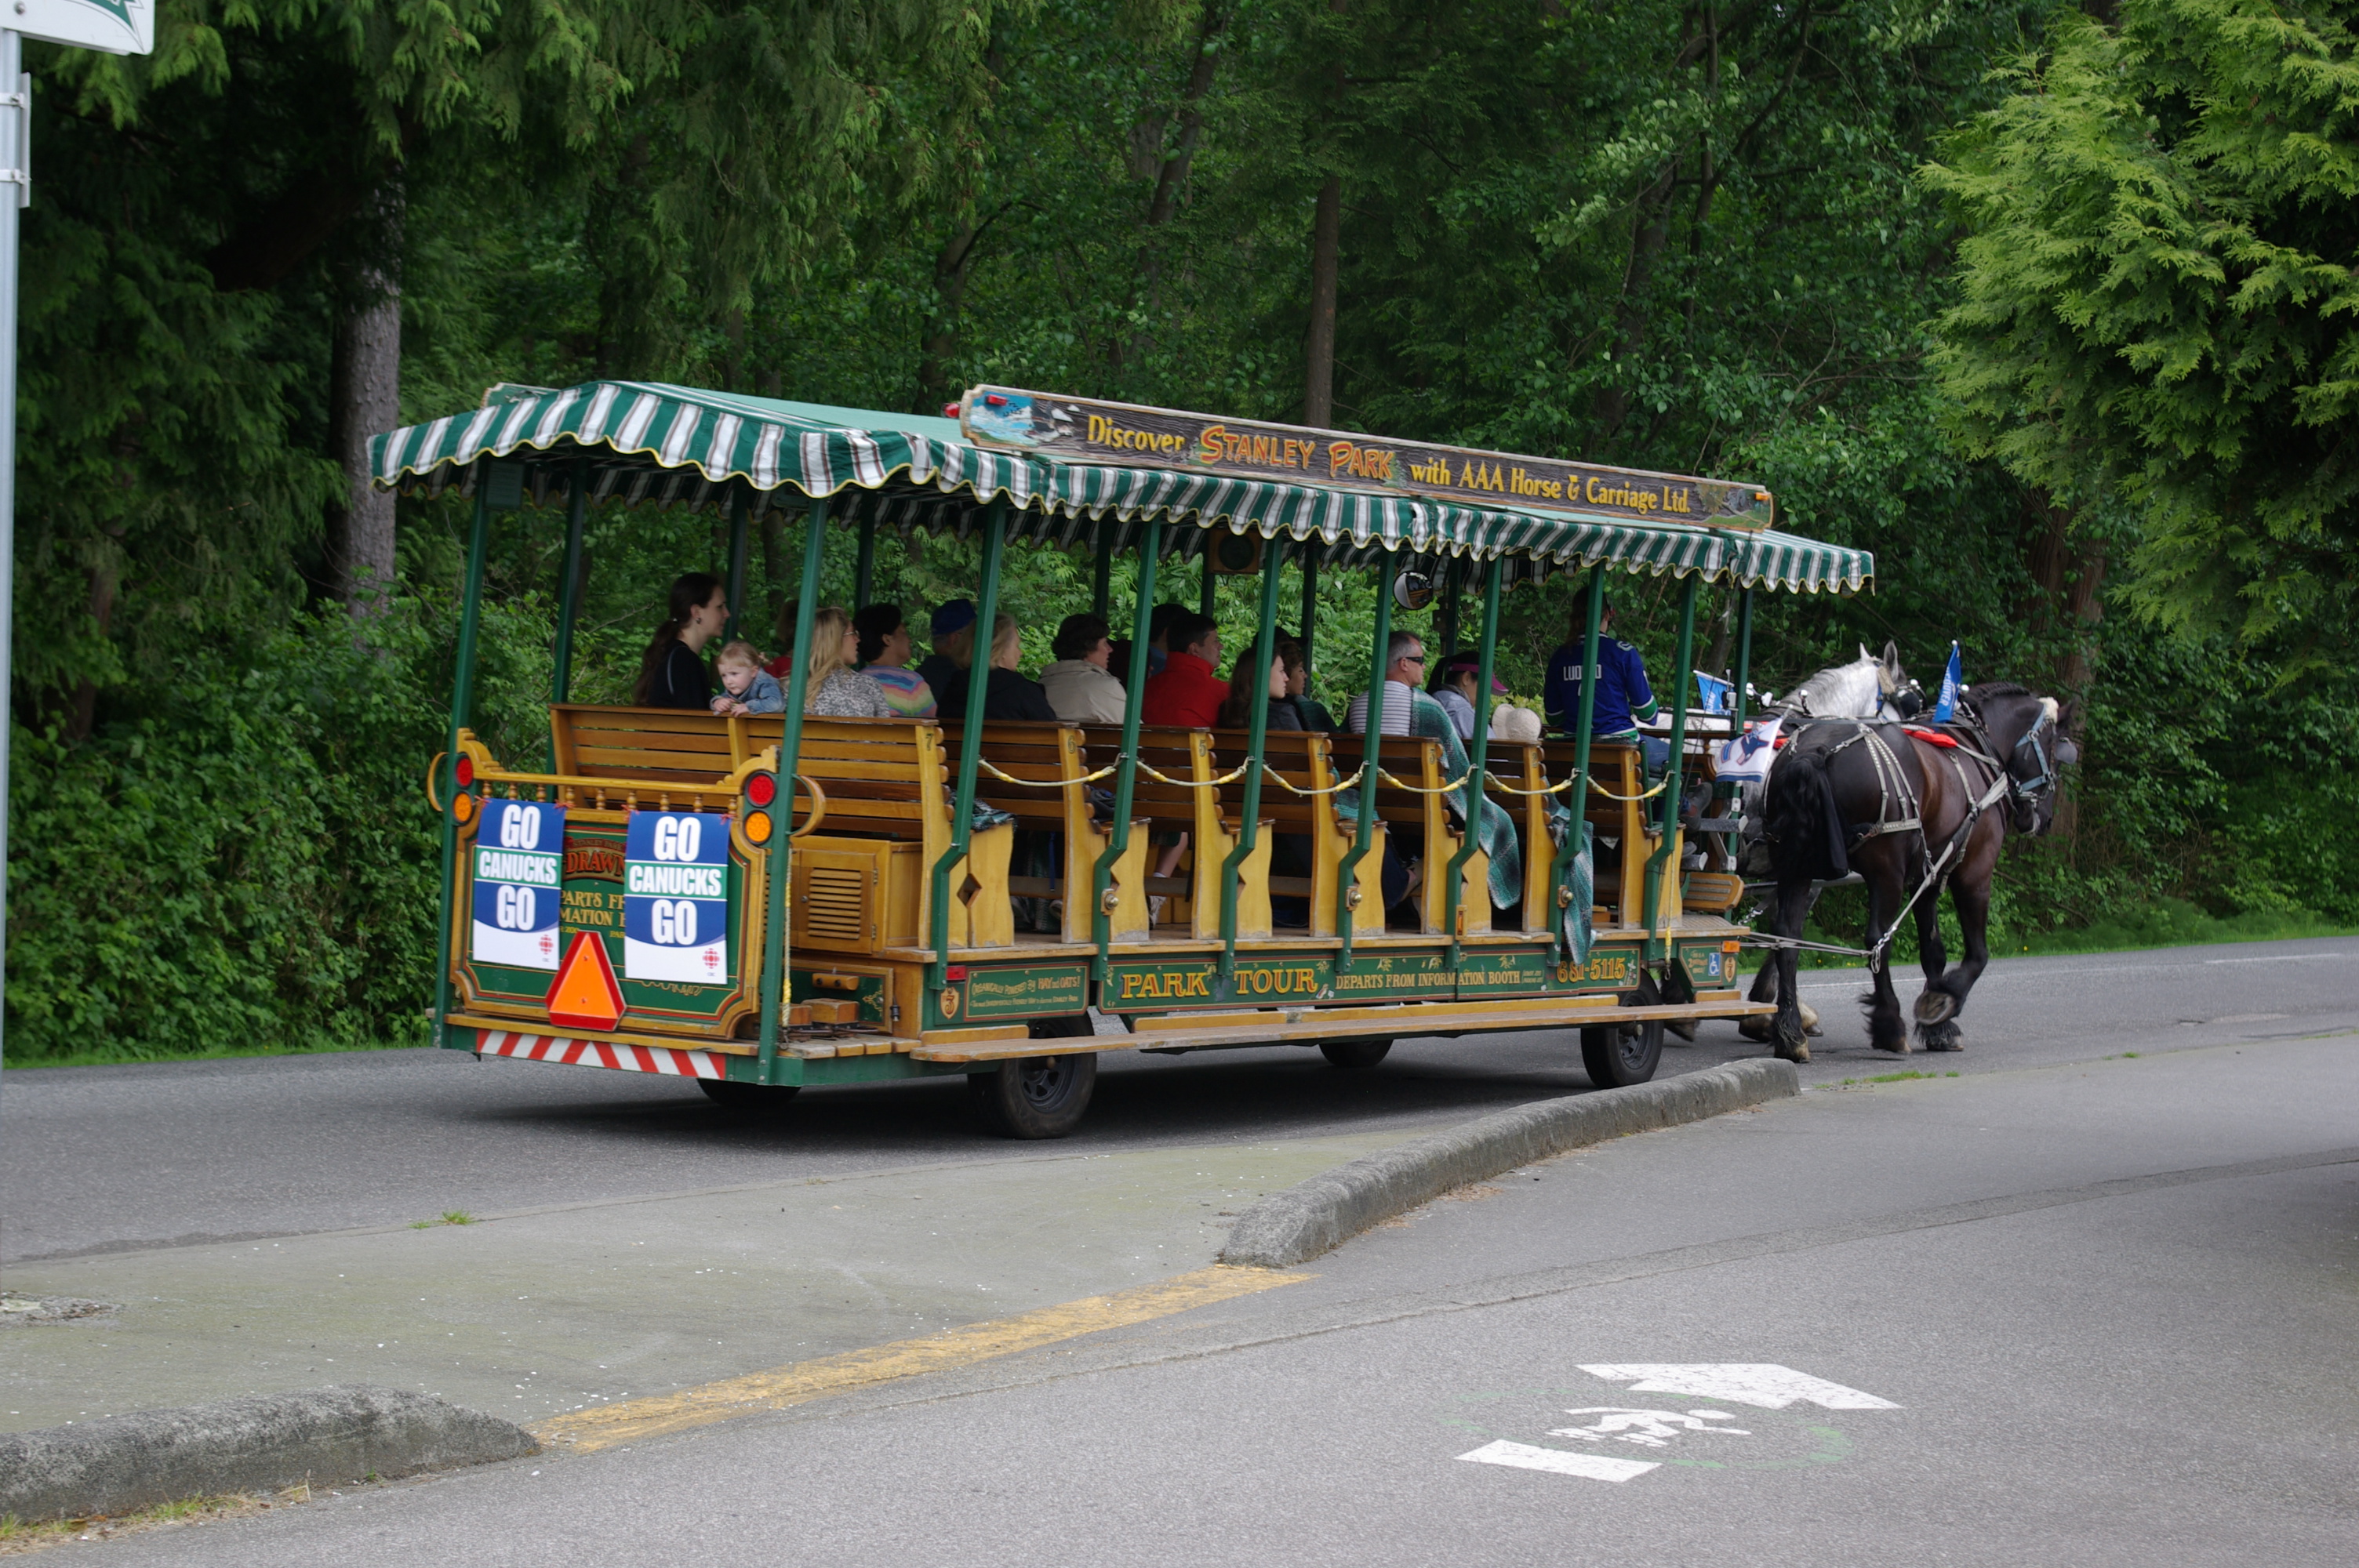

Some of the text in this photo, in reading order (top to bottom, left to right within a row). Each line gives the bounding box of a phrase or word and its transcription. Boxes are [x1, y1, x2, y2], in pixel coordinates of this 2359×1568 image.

[1088, 415, 1691, 515] Discover STANLEY PARK with AAA Horse & Carriage Ltd.
[1563, 664, 1602, 681] LUOO
[925, 732, 933, 751] 7
[1067, 735, 1075, 753] 6
[1198, 739, 1206, 757] 5
[1318, 744, 1324, 761] 4
[500, 804, 541, 850] GO
[653, 815, 701, 862] GO
[478, 851, 557, 884] CANUCKS
[629, 865, 722, 896] CANUCKS
[496, 884, 536, 931] GO
[560, 890, 602, 908] PARTS
[560, 908, 614, 926] MATION
[652, 898, 697, 946] GO
[1038, 978, 1052, 990] HAY
[1121, 968, 1319, 999] PARK TOUR
[1335, 974, 1383, 989] DEPARTS
[1385, 973, 1416, 988] FROM
[1418, 971, 1485, 987] INFORMATION
[1488, 970, 1521, 984] BOOTH
[944, 995, 955, 1014] 3
